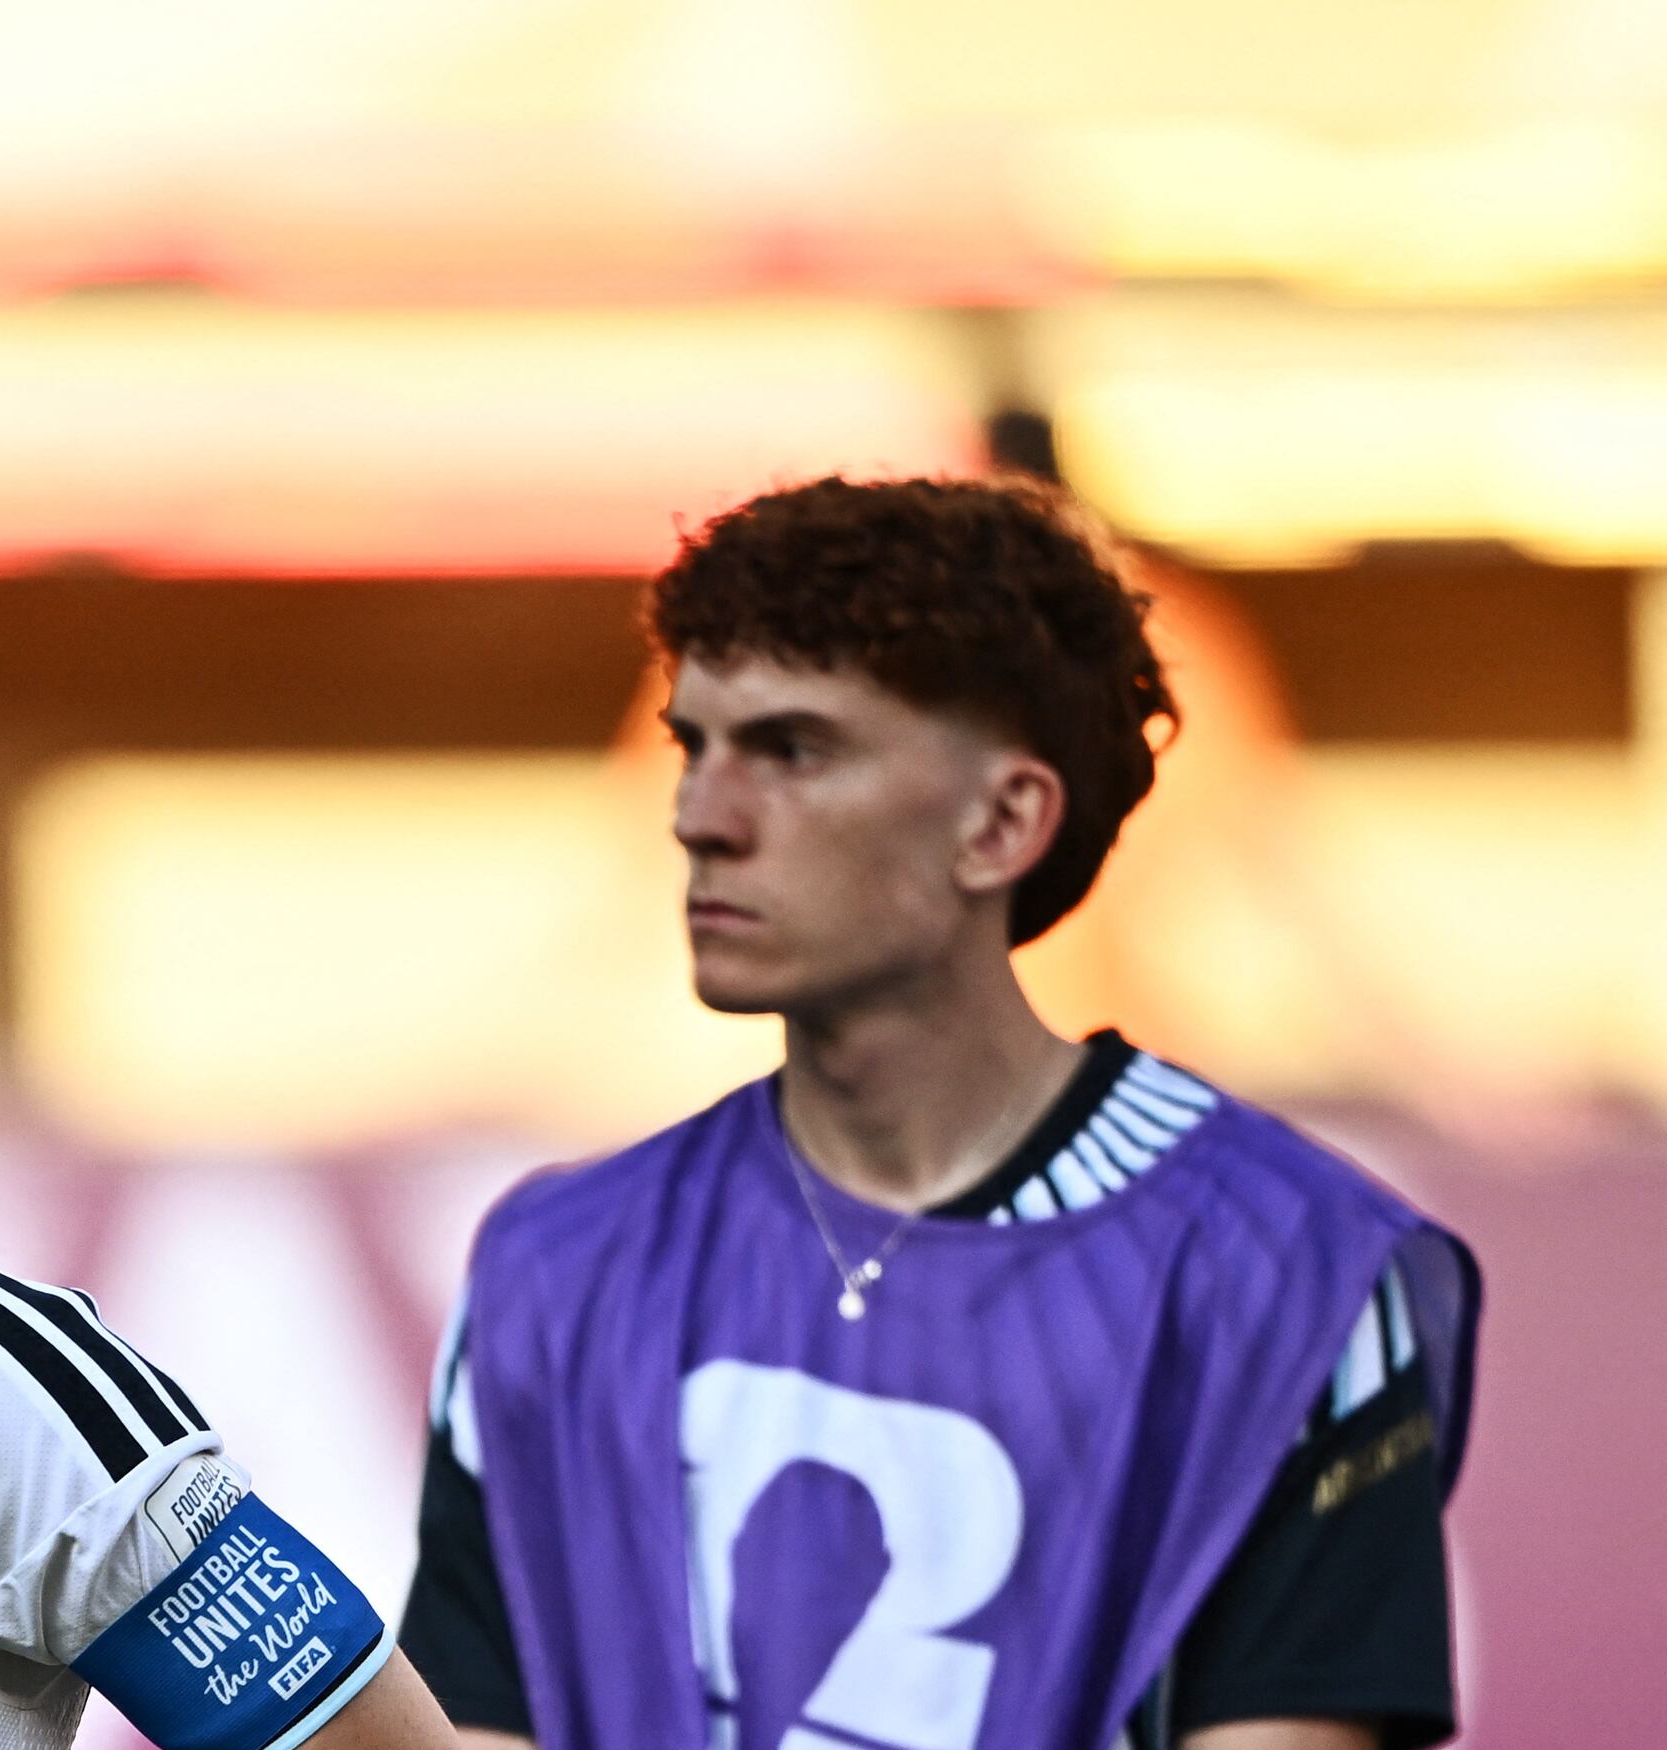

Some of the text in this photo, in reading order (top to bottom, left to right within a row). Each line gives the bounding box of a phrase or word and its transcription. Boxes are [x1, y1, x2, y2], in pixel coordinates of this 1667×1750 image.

[170, 1456, 220, 1525] FOOTBALL
[148, 1525, 267, 1637] FOOTBALL
[171, 1546, 300, 1669] UNITES
[204, 1572, 337, 1705] the World
[275, 1644, 328, 1694] FIFA
